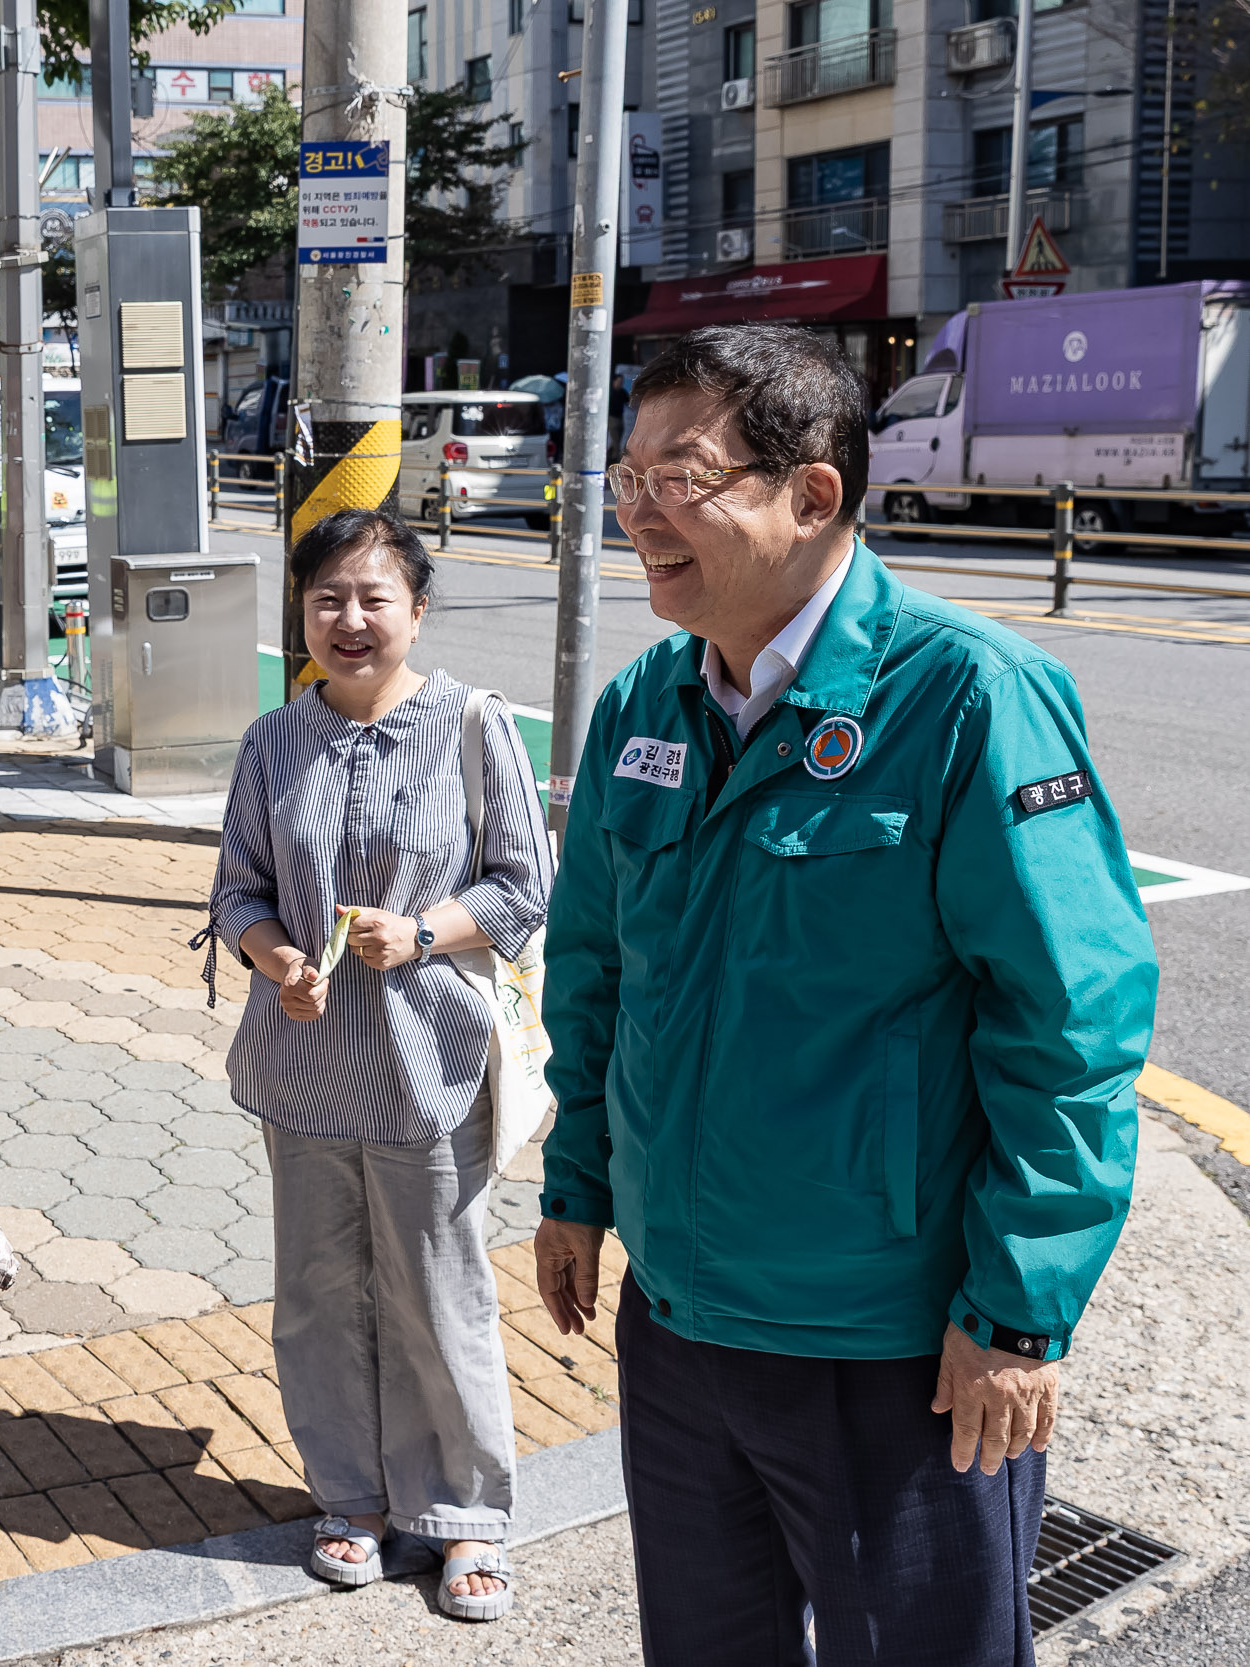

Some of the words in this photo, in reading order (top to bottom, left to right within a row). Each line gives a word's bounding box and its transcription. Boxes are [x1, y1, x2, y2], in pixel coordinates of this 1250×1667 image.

[304, 151, 353, 174] 경고!
[302, 192, 312, 202] 이
[314, 192, 340, 202] 지역은
[343, 191, 387, 201] 범죄예방을
[302, 205, 320, 215] 위해
[322, 204, 358, 214] CCTV가
[302, 218, 337, 228] 작동되고
[339, 217, 379, 228] 있습니다.
[1009, 369, 1143, 395] MAZIALOOK
[645, 744, 660, 761] 김
[666, 749, 682, 766] 경호
[1029, 775, 1084, 806] 광진구
